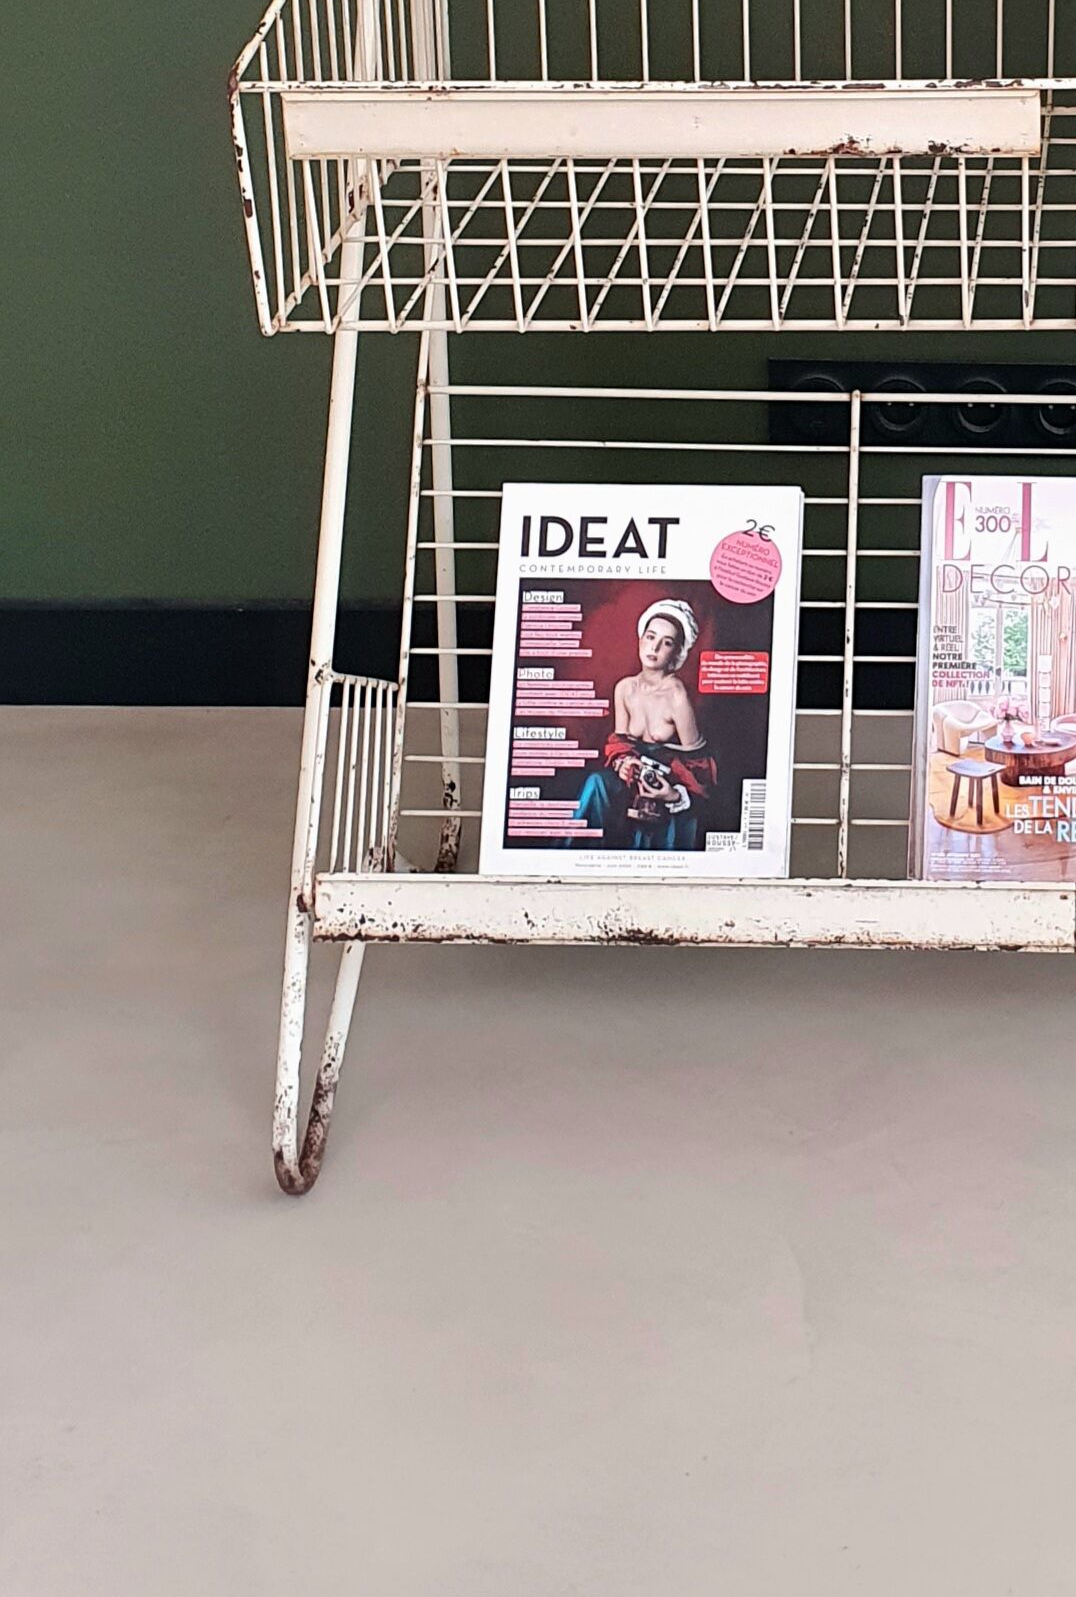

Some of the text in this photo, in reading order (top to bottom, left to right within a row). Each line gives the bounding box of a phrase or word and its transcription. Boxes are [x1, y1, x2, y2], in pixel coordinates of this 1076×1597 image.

[975, 515, 1011, 533] 300
[520, 515, 680, 559] IDEAT
[519, 564, 667, 575] CONTEMPORARY LIFE
[524, 591, 564, 603] Design
[933, 625, 958, 634] ENTRE
[518, 669, 554, 680] Photo
[932, 671, 990, 679] COLLECTION
[514, 728, 566, 740] Lifestyle
[1019, 776, 1043, 786] BAIN
[1044, 776, 1056, 786] DE
[512, 787, 539, 799] Trips
[1043, 786, 1052, 795] &
[1005, 802, 1031, 819] LES
[1013, 819, 1033, 835] DE
[1034, 820, 1053, 835] LA
